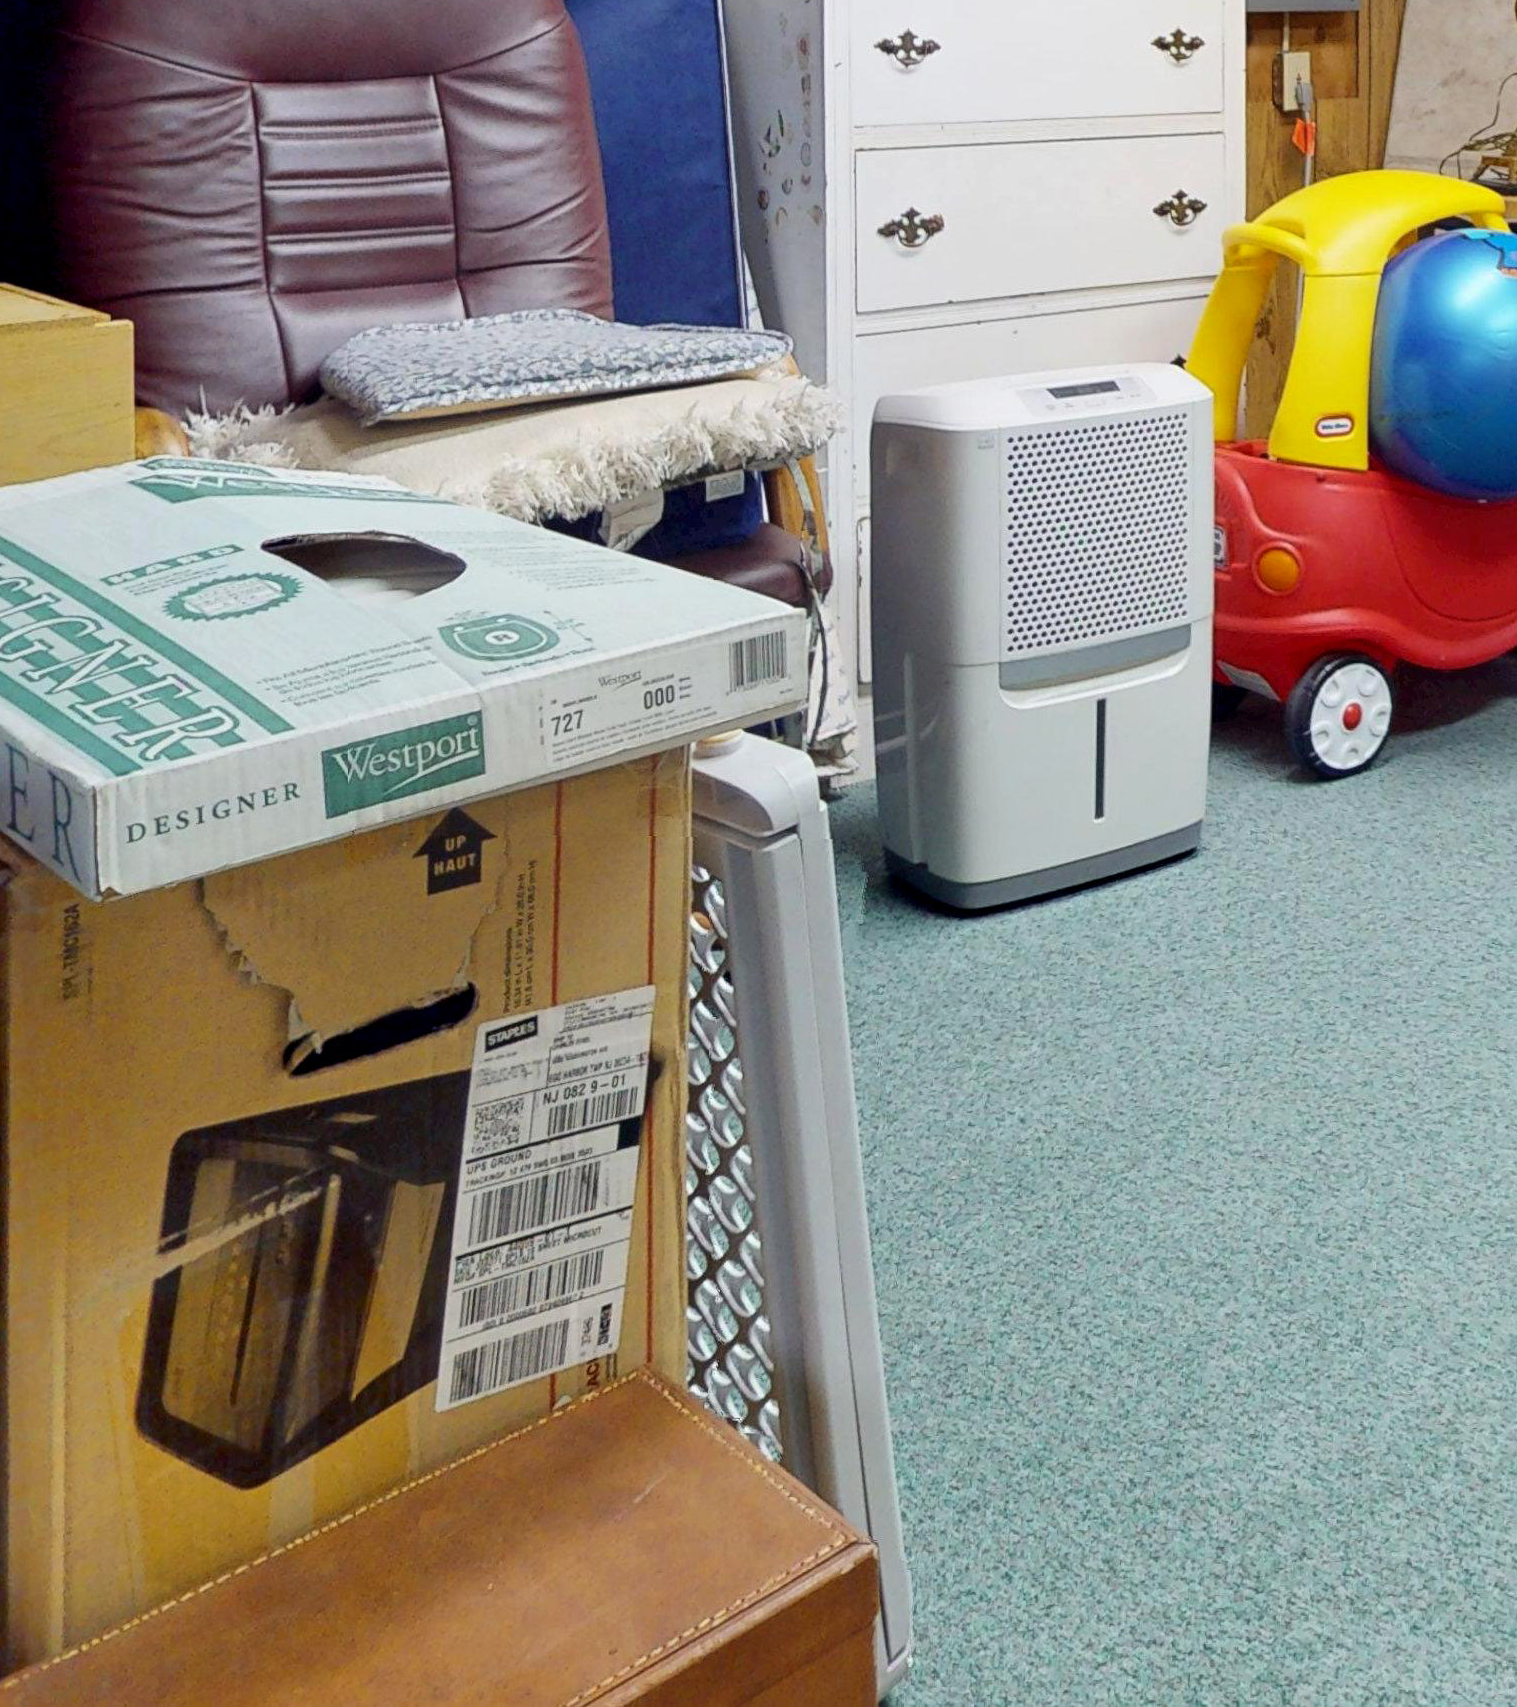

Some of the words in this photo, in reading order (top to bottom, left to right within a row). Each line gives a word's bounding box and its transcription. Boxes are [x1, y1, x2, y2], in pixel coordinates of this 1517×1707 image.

[106, 544, 238, 586] HARD
[643, 684, 676, 710] 000
[551, 708, 585, 737] 727
[332, 726, 480, 785] Westport
[126, 781, 302, 844] DESIGNER
[444, 834, 467, 852] UP
[434, 853, 476, 876] HAUT
[486, 1018, 538, 1047] STAPLES
[542, 1091, 559, 1105] NJ
[466, 1161, 488, 1175] UPS
[490, 1149, 533, 1169] GROUND
